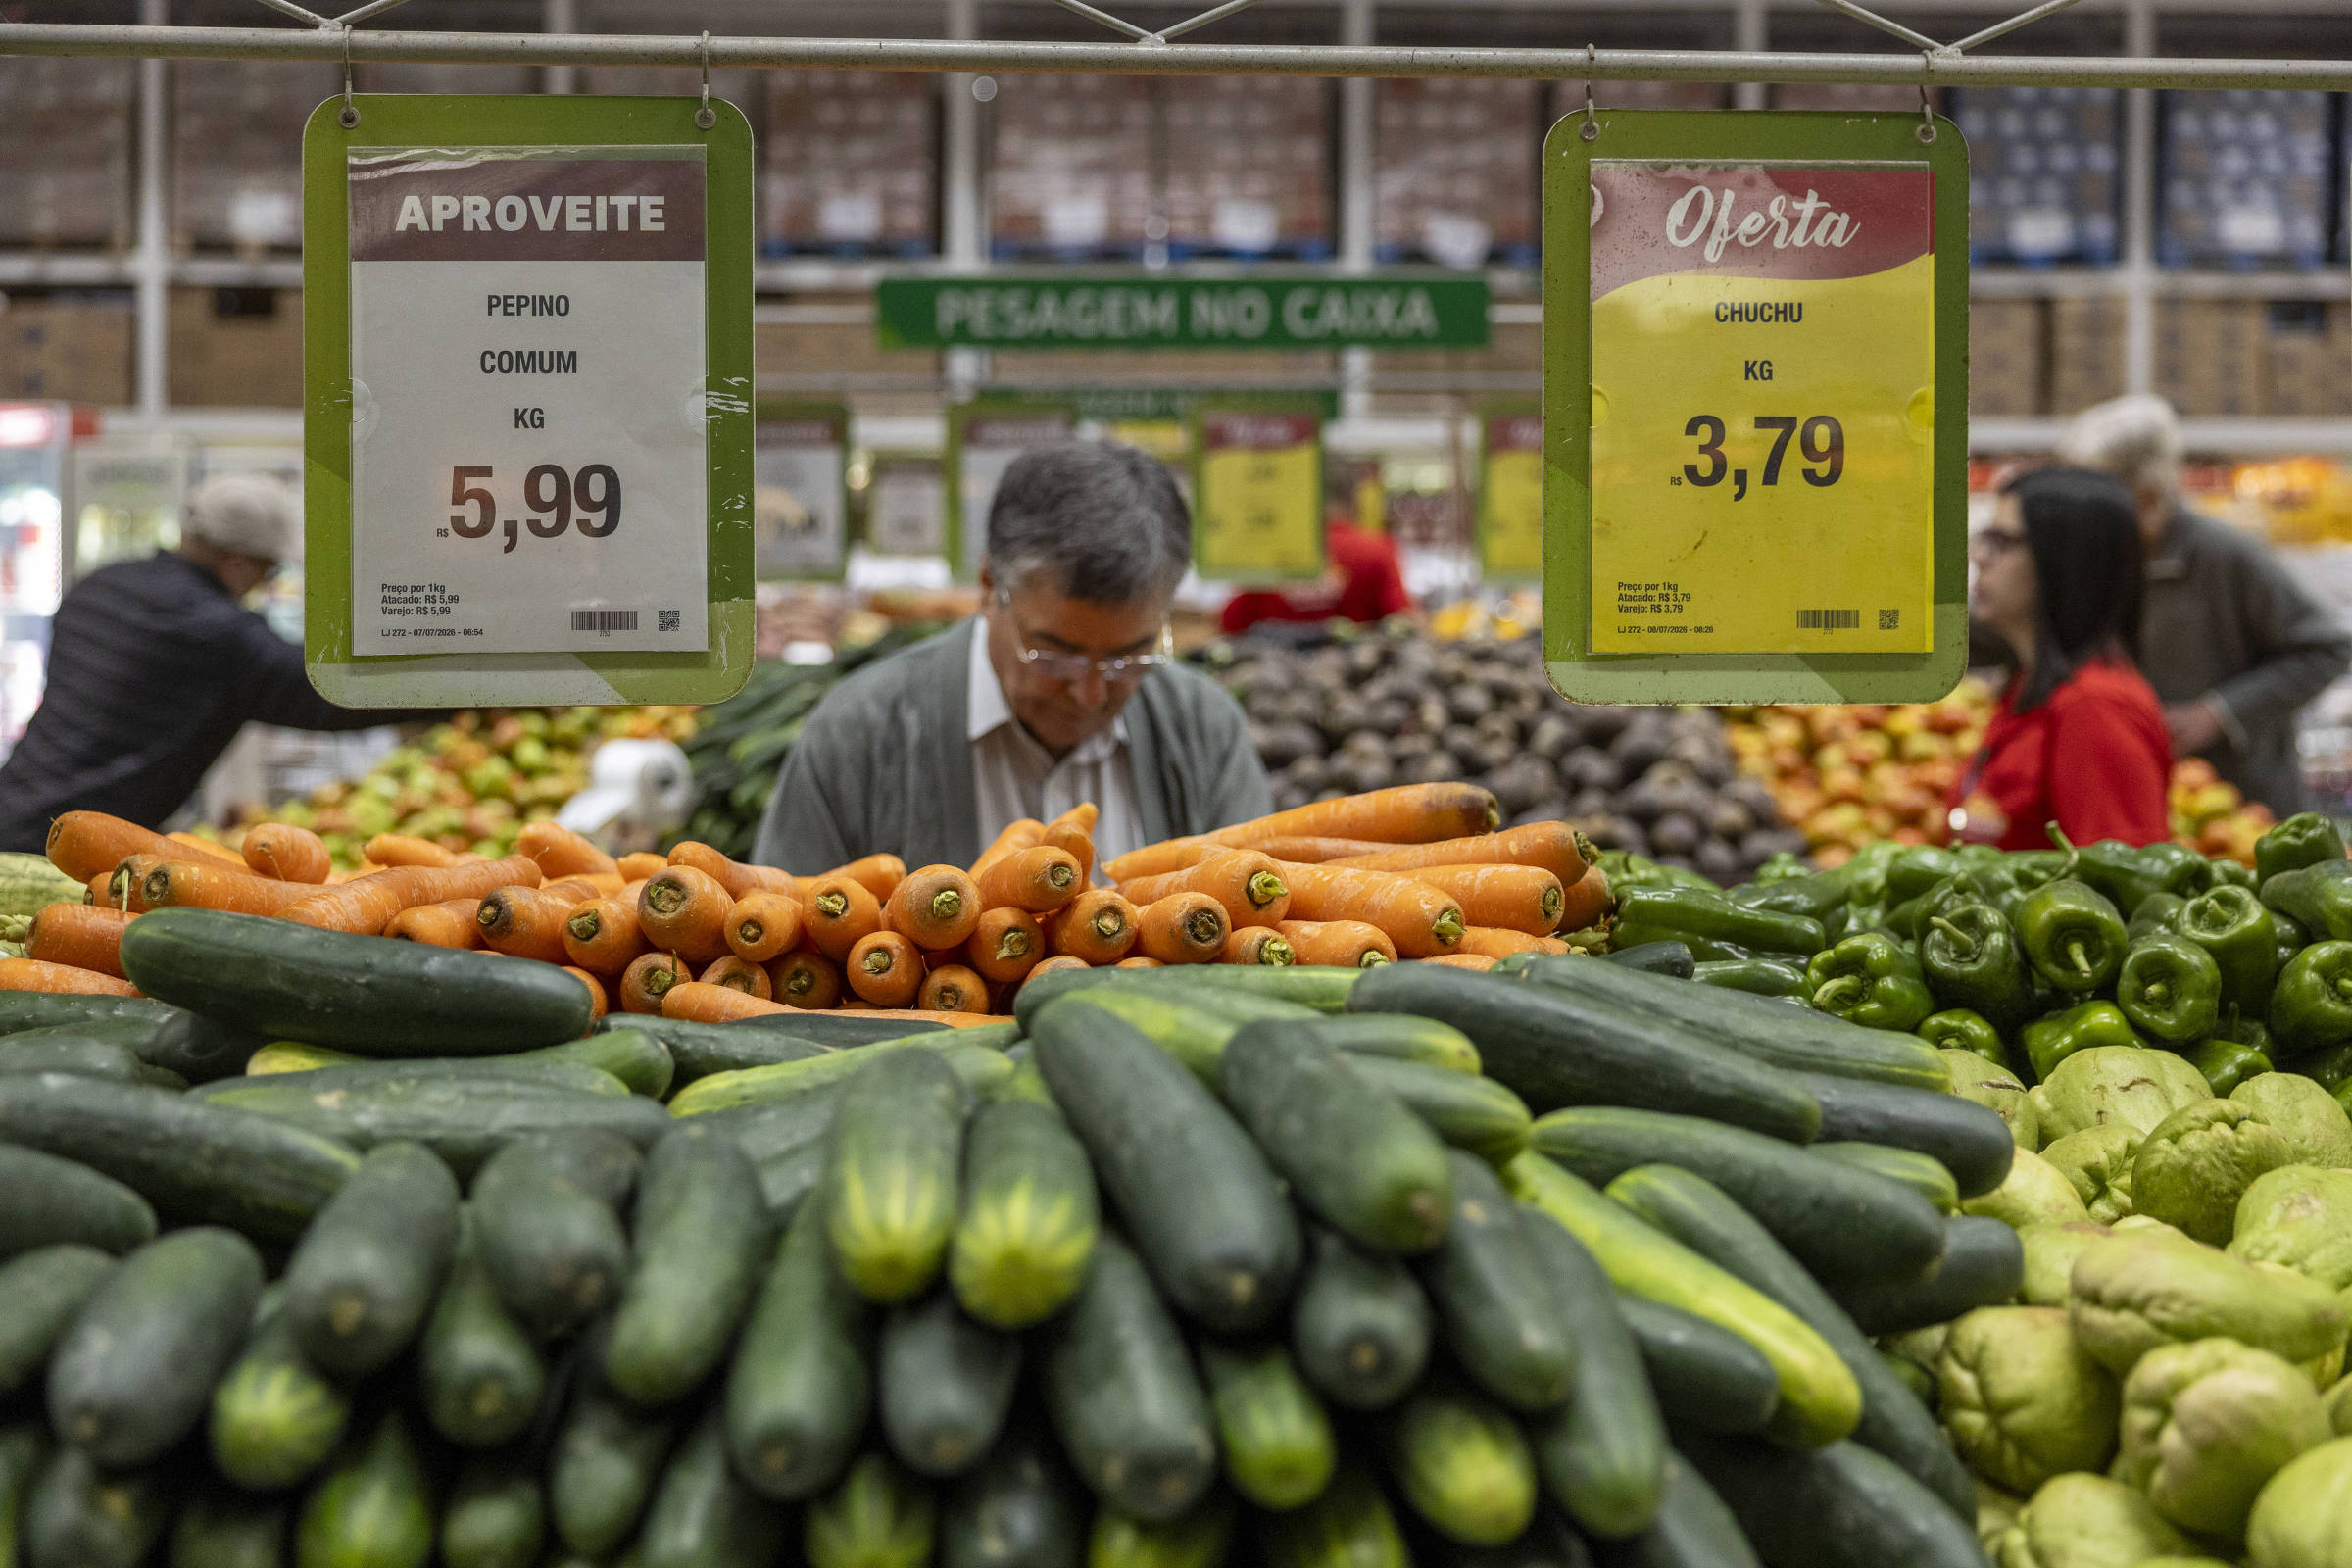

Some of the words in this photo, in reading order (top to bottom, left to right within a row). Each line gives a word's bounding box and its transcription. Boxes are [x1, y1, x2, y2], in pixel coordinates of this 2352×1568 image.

[395, 195, 666, 232] APROVEITE
[1666, 185, 1861, 263] Oferta
[487, 294, 570, 317] PEPINO
[935, 288, 1178, 339] PESAGEM
[1189, 288, 1271, 339] NO
[1282, 288, 1439, 339] CAIXA
[1715, 302, 1803, 323] CHUCHU
[479, 350, 578, 374] COMUM
[1744, 360, 1774, 381] KG
[514, 407, 545, 429] KG
[1670, 476, 1683, 486] R$
[1683, 415, 1845, 502] 3,79
[436, 528, 449, 538] R$
[450, 464, 622, 554] 5,99
[381, 583, 408, 595] Preço
[410, 585, 425, 594] por
[428, 583, 445, 594] 1kg
[1618, 582, 1642, 593] Preço
[1644, 584, 1660, 593] por
[1662, 582, 1678, 592] 1kg
[1618, 593, 1656, 603] Atacado:
[1658, 593, 1670, 603] R$
[1672, 593, 1690, 603] 3,79
[381, 595, 422, 605] Atacado:
[424, 595, 437, 605] R$
[439, 595, 460, 605] 5,99
[1618, 604, 1648, 614] Varejo:
[1650, 604, 1662, 613] R$
[1664, 604, 1683, 613] 3,79
[381, 607, 414, 616] Varejo:
[416, 607, 428, 615] R$
[430, 607, 451, 616] 5,99
